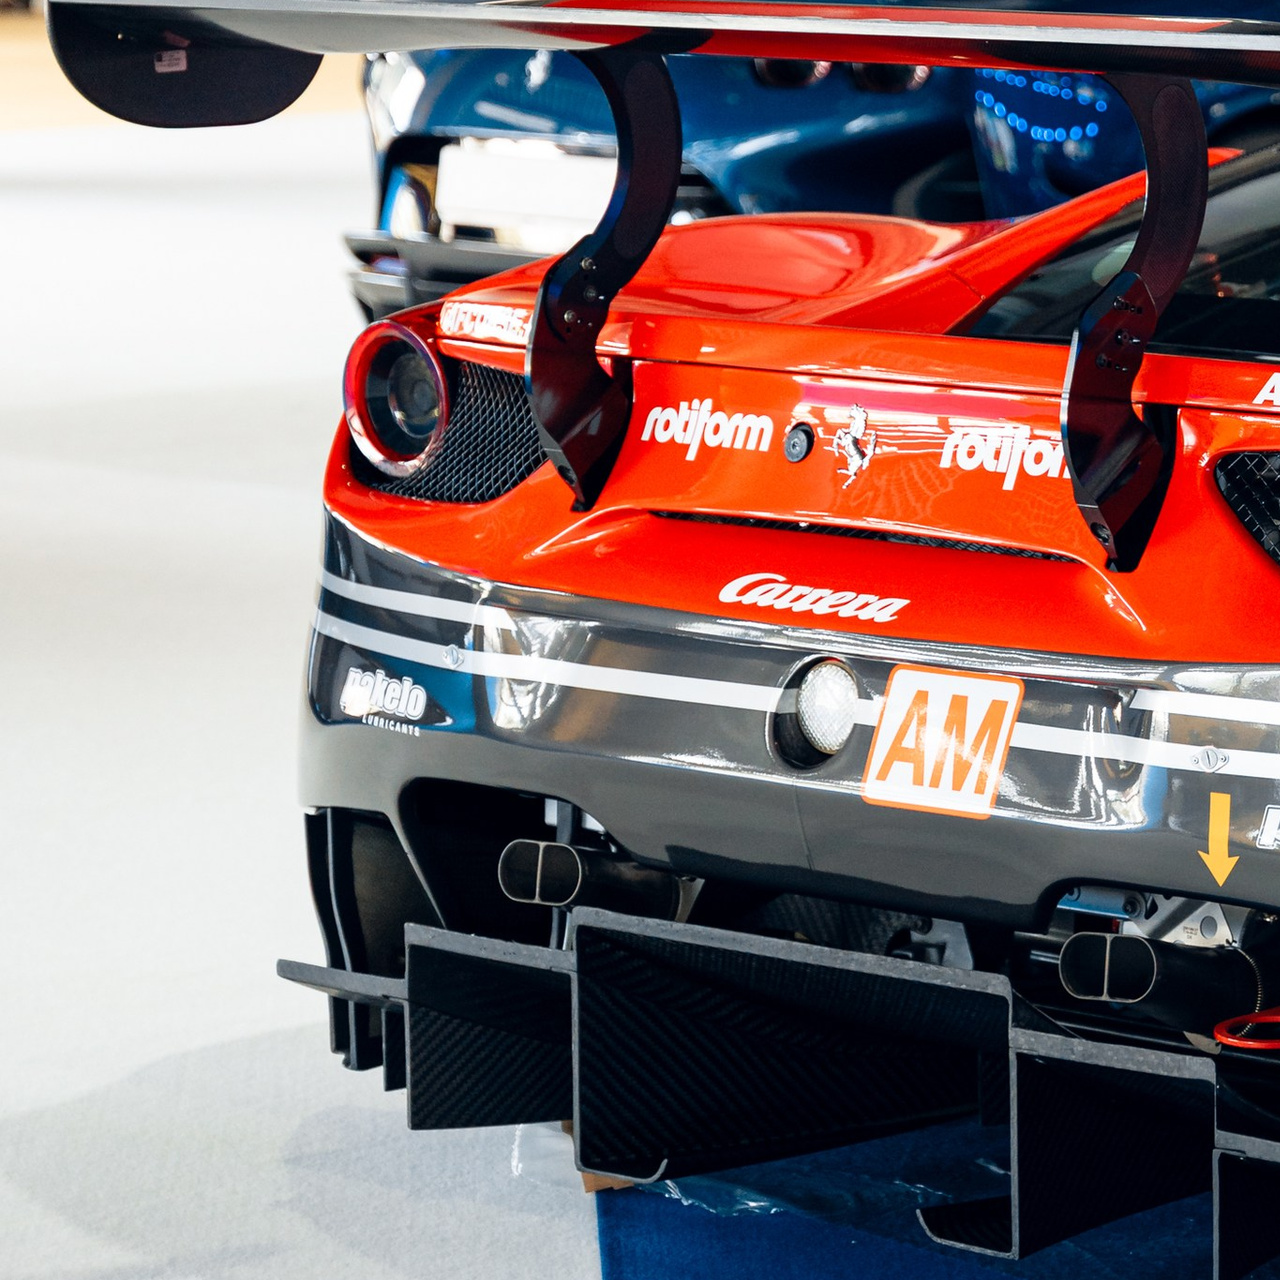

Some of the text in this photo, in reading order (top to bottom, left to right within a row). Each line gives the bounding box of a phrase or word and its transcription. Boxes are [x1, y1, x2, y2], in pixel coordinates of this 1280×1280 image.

[641, 398, 773, 461] rotiform
[718, 573, 911, 623] Carrera
[340, 667, 427, 721] pakelo
[361, 714, 420, 738] LUBRICANTS
[876, 690, 1009, 795] AM
